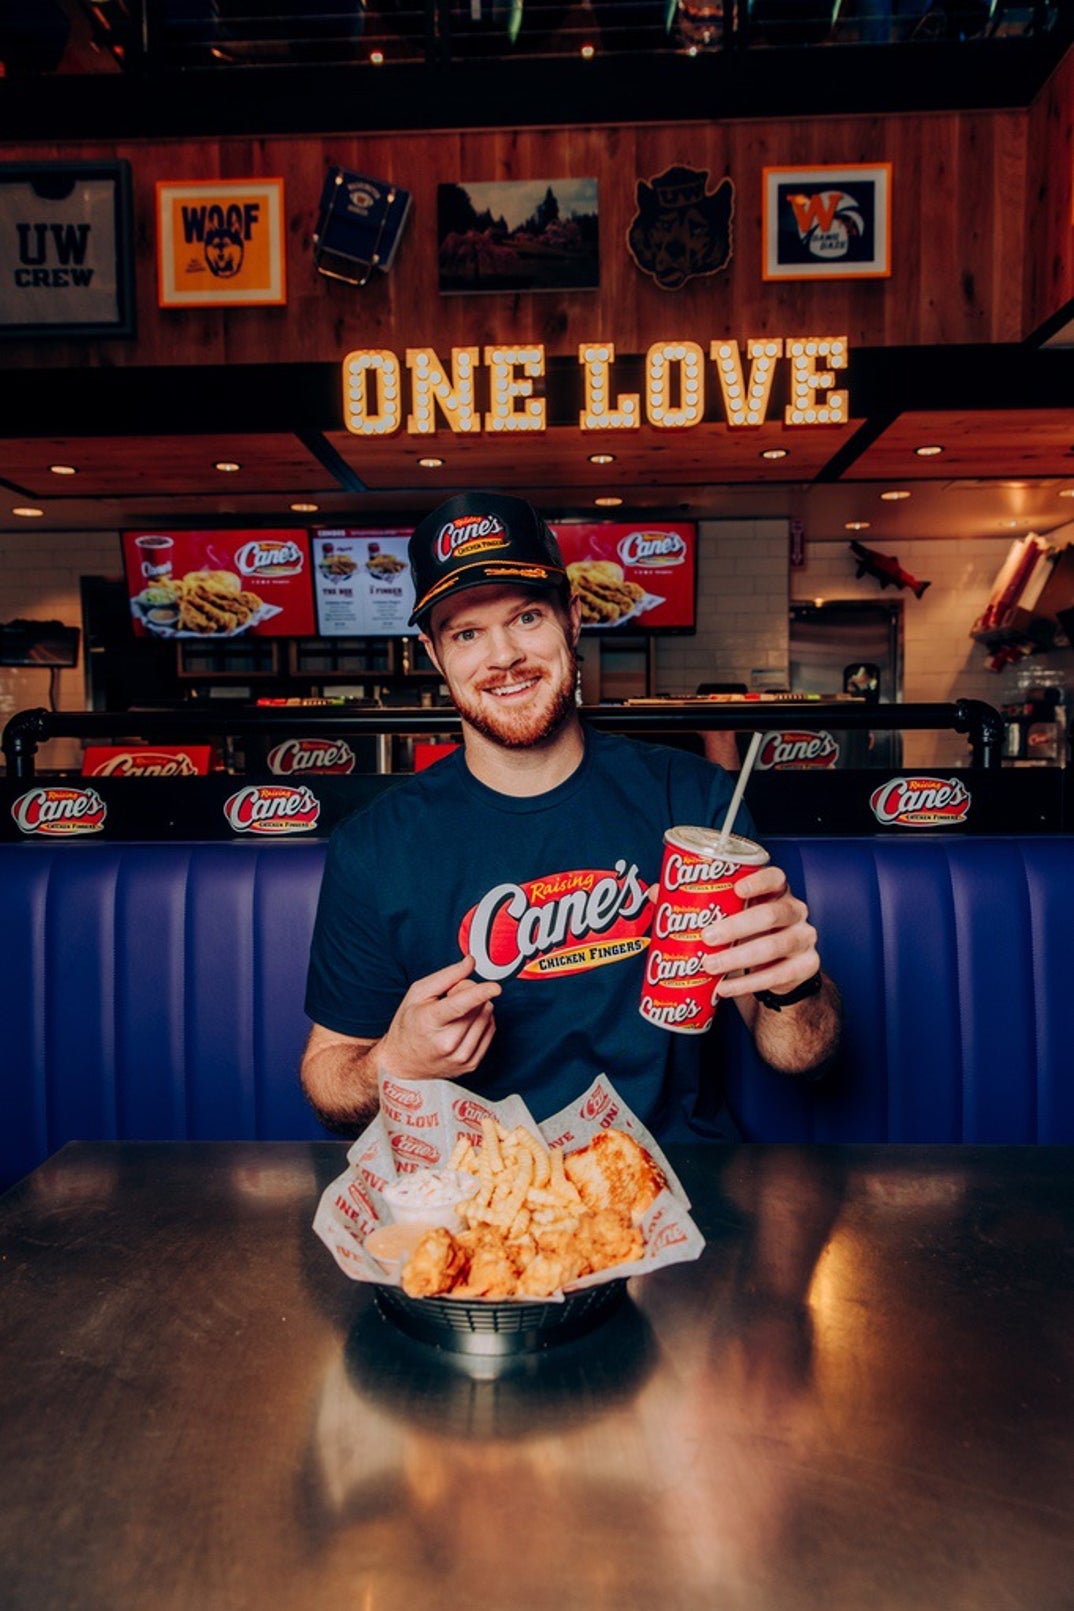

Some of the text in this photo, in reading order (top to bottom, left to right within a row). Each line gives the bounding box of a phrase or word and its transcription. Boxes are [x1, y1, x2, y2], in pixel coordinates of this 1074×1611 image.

[181, 203, 260, 243] WOOF
[16, 223, 91, 266] UW
[14, 268, 94, 288] CREW
[343, 337, 848, 435] ONE LOVE
[239, 541, 300, 573] Cane's
[437, 515, 504, 562] Cane's
[622, 532, 683, 564] Cane's
[273, 739, 352, 775] Cane's
[757, 731, 837, 769] Cane's
[260, 789, 291, 798] Raising
[876, 778, 968, 821] Cane's
[909, 781, 942, 790] Raising
[18, 788, 104, 830] Cane's
[229, 787, 317, 829] Cane's
[530, 873, 595, 903] Raising
[664, 854, 740, 891] Canes
[468, 859, 650, 980] Cane's
[656, 902, 728, 939] Cane's
[539, 939, 642, 971] CHICKEN FINGERS
[640, 996, 702, 1024] Cane's
